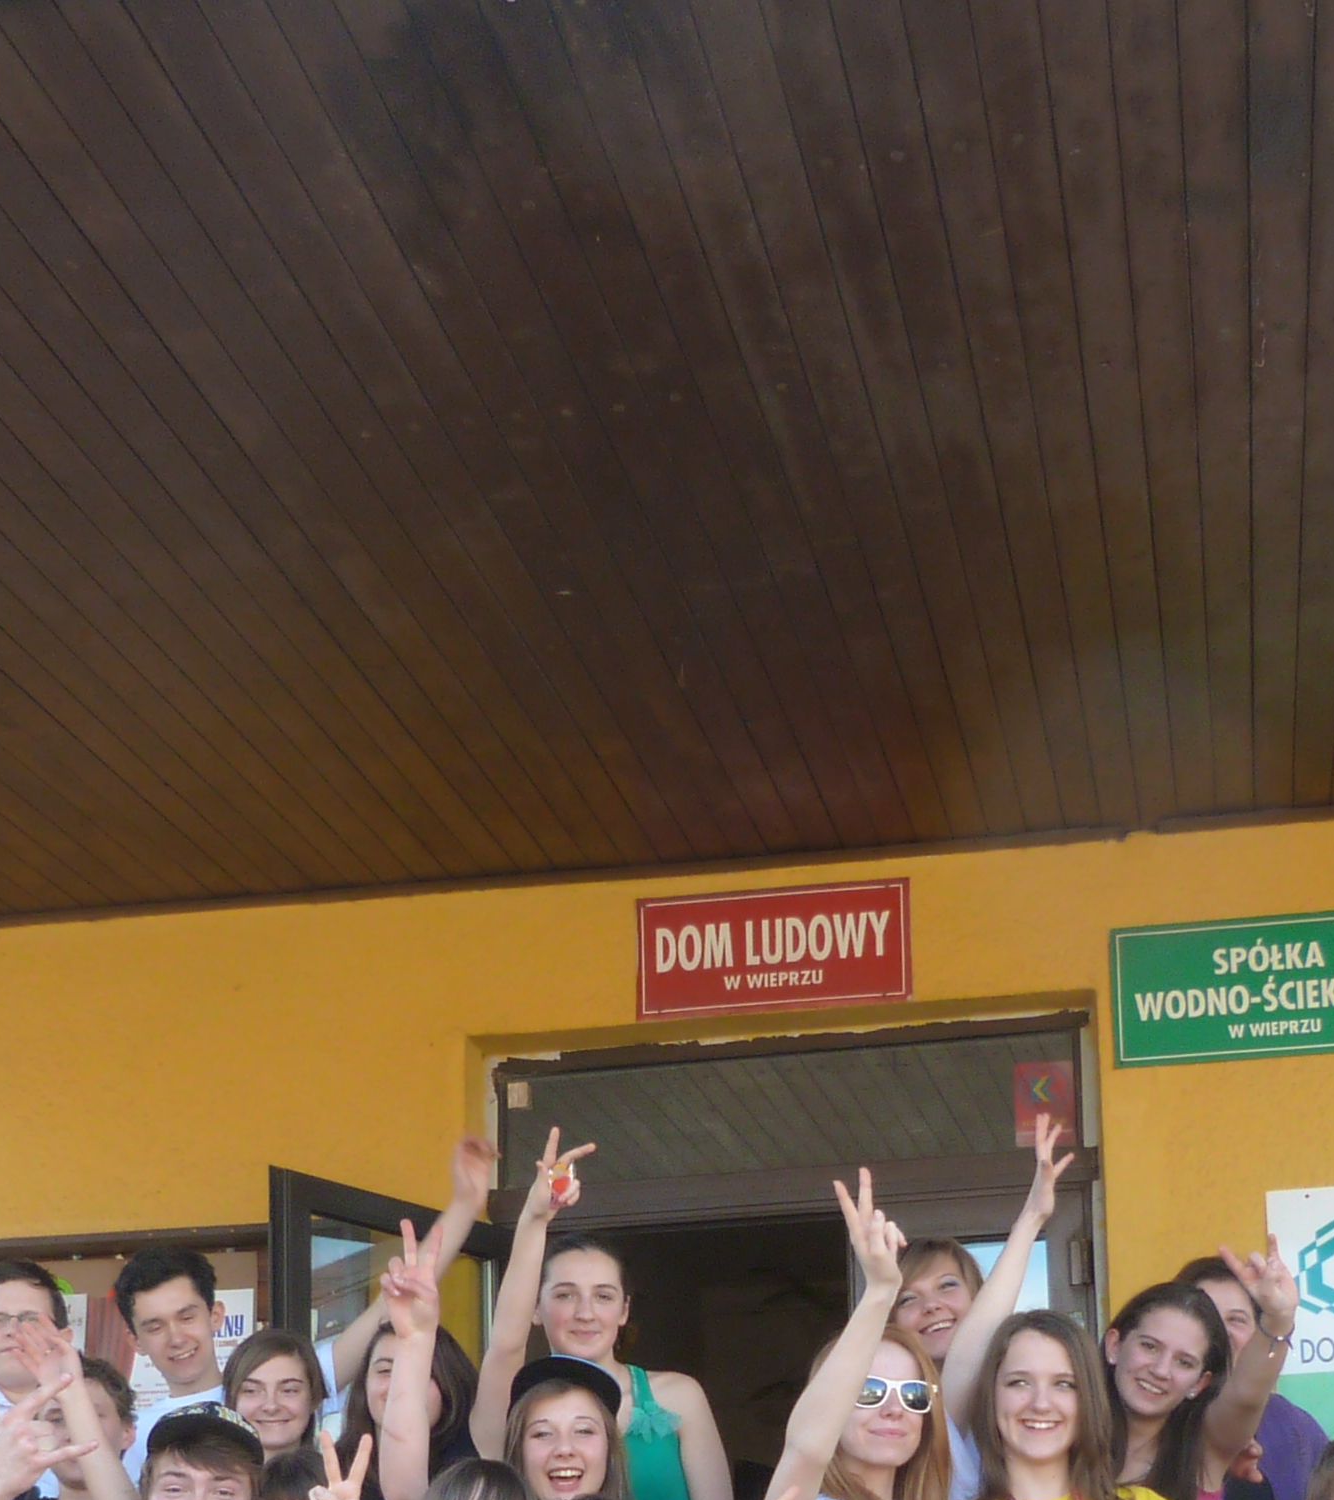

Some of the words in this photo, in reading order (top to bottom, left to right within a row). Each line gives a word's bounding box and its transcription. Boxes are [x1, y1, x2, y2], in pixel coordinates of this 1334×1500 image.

[655, 922, 734, 974] DOM
[745, 910, 890, 966] LUDOWY
[1212, 937, 1325, 976] SPÓŁKA
[724, 975, 741, 990] W
[747, 969, 823, 988] WIEPRZU
[1228, 1024, 1244, 1039] W
[1249, 1018, 1322, 1037] WIEPRZU
